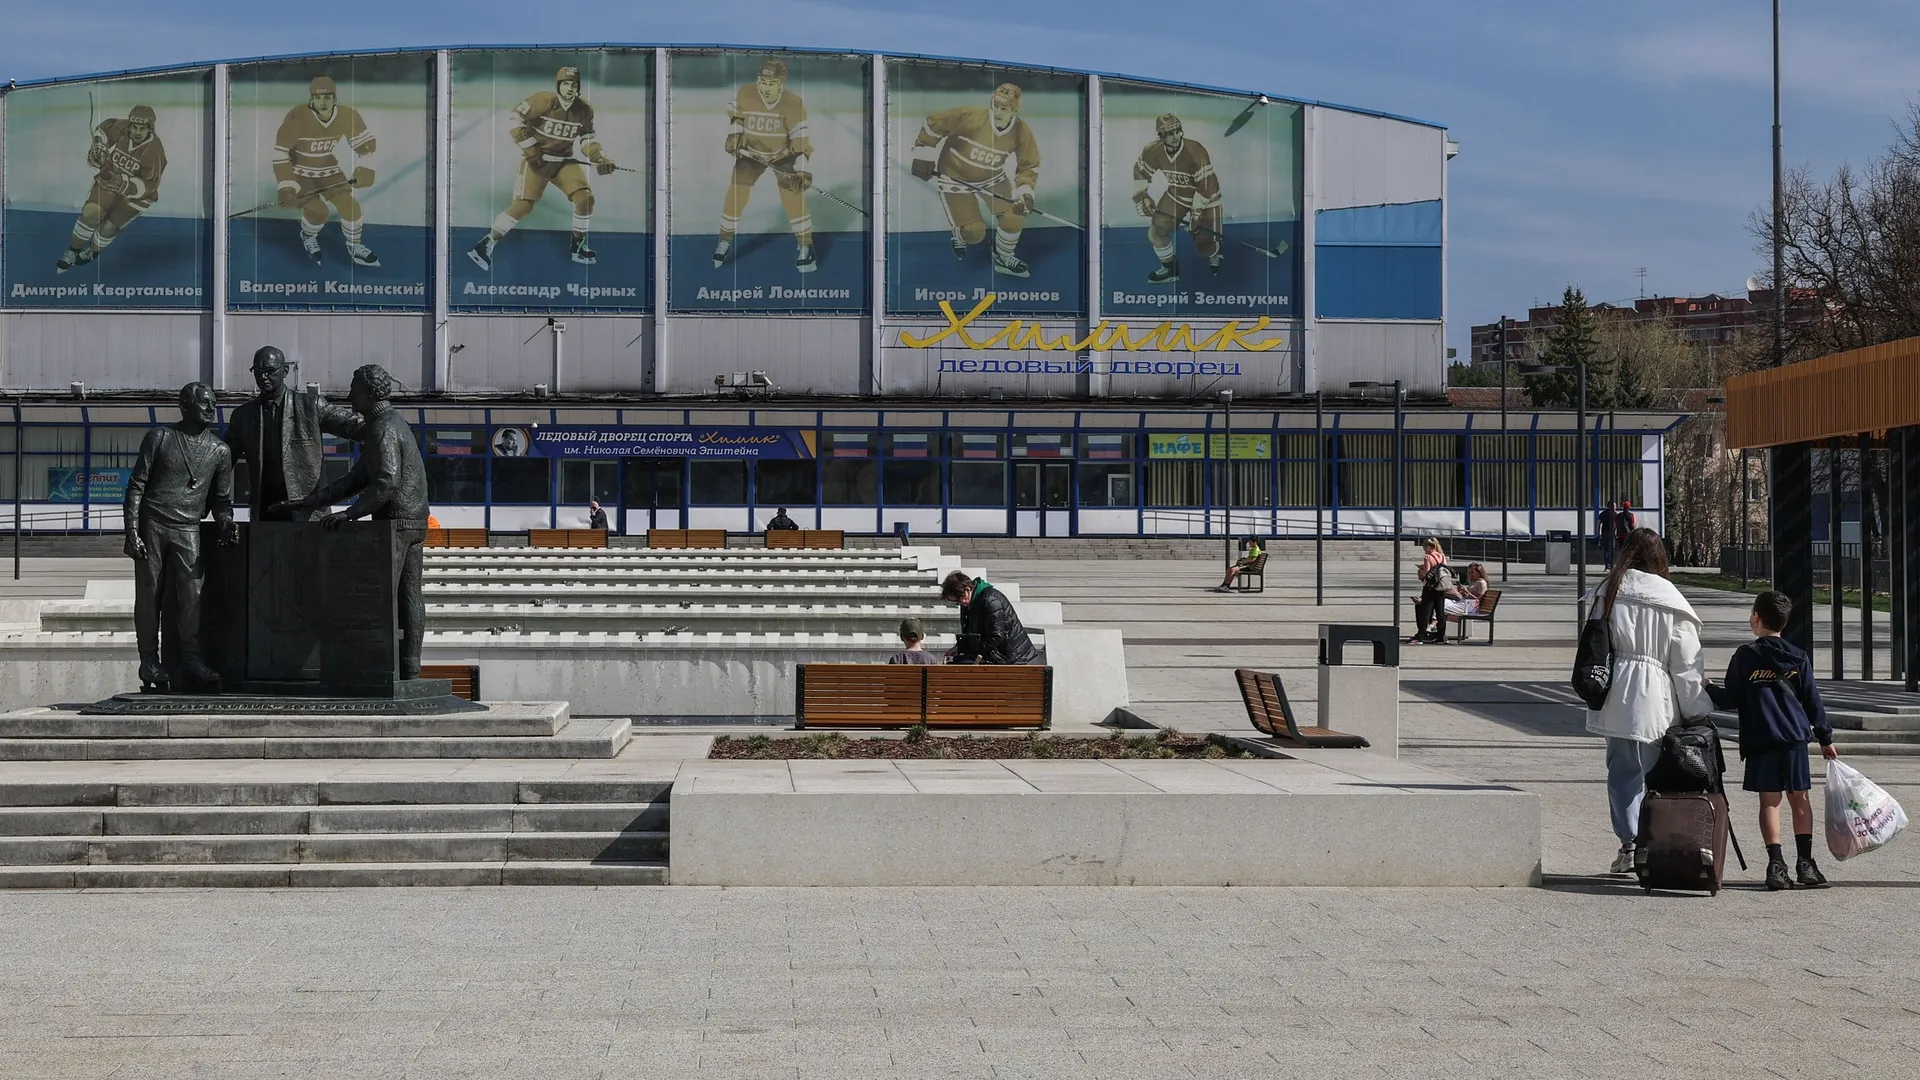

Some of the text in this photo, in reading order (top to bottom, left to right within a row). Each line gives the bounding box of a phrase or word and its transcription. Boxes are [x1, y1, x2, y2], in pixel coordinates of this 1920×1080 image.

[129, 116, 149, 124] СССР
[747, 116, 781, 133] СССР
[1164, 122, 1181, 131] СССР
[543, 121, 578, 138] СССР
[310, 139, 338, 152] СССР
[112, 152, 140, 172] СССР
[970, 147, 1002, 166] СССР
[1166, 173, 1190, 185] СССР
[11, 283, 203, 299] Дмитрий Квартальнов
[239, 280, 425, 296] Валерий Каменский
[463, 281, 637, 299] Александр Черных
[696, 285, 850, 302] Андрей Ломакин
[915, 288, 967, 302] Игорь
[1113, 291, 1289, 307] Валерий Зелепукин
[899, 294, 1283, 352] Химик
[937, 356, 1242, 380] ледовый дворец
[536, 430, 597, 442] ЛЕДОВЫЙ
[598, 431, 647, 443] ДВОРЕЦ
[649, 431, 693, 442] СПОРТА
[564, 445, 759, 456] им. Николая Семёновича Эпштейна
[1152, 441, 1202, 455] КАФЕ
